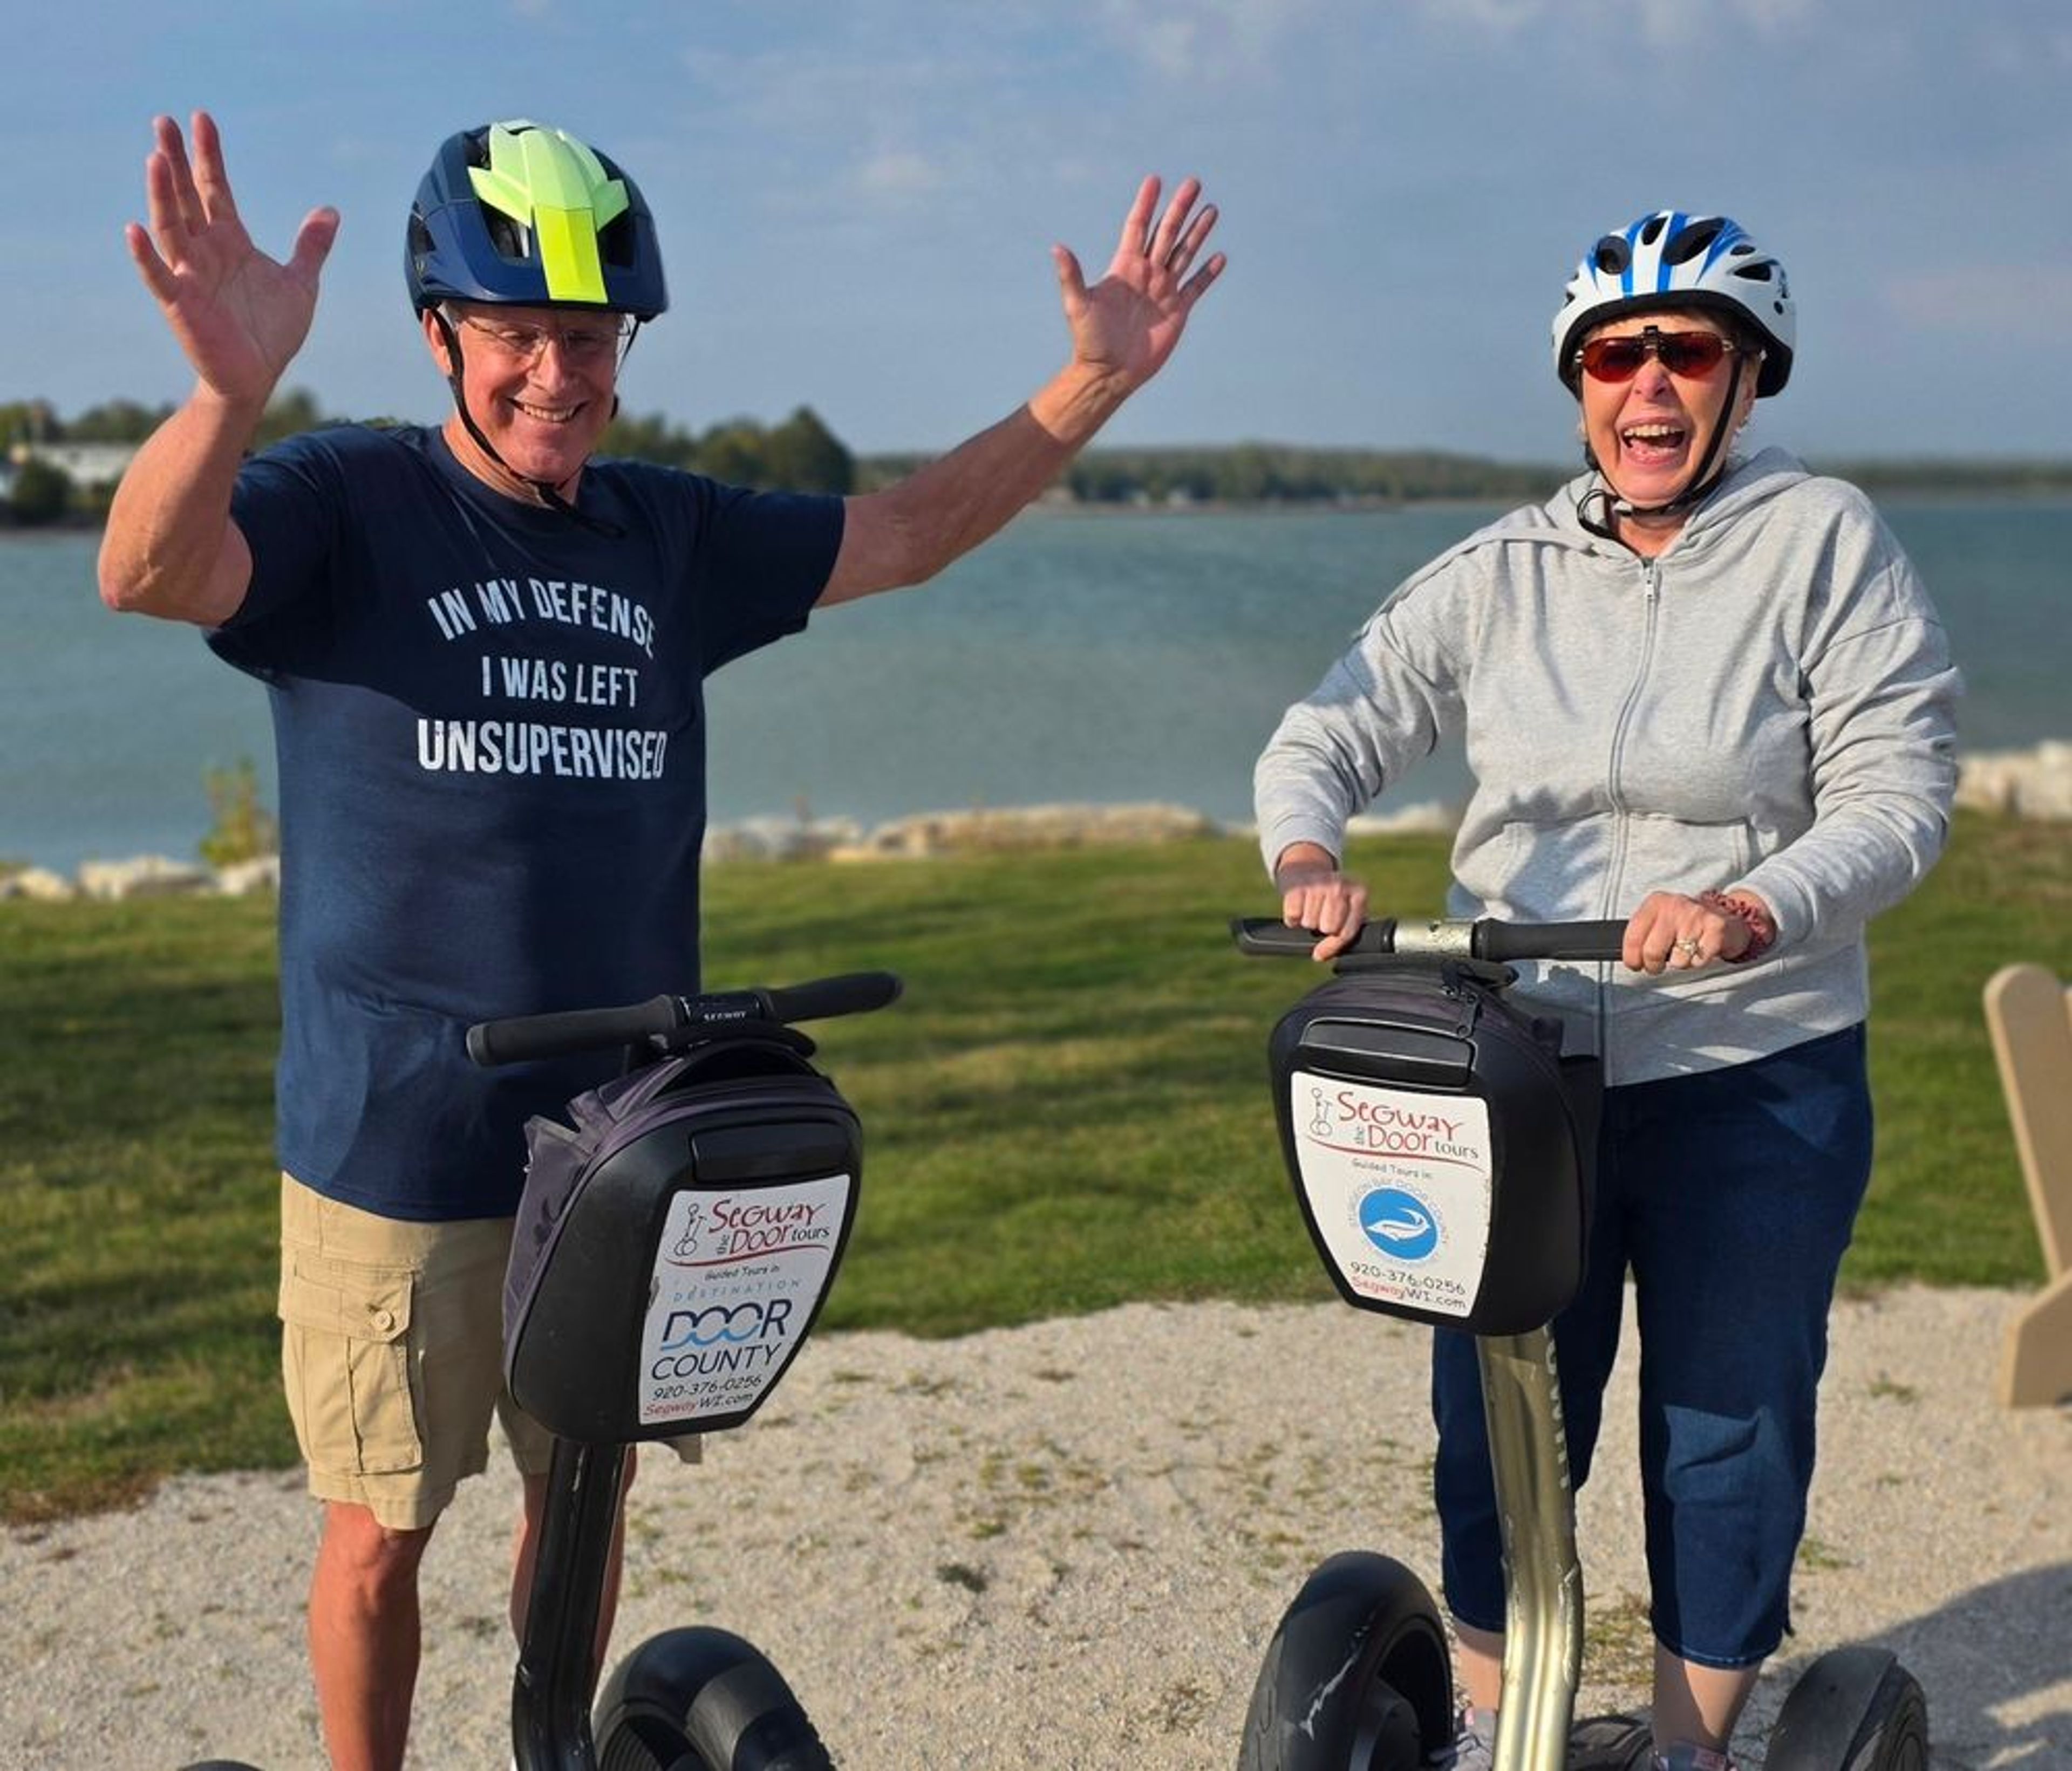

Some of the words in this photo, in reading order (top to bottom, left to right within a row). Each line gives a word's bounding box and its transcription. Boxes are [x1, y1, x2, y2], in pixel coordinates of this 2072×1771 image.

[428, 588, 477, 640] IN
[475, 578, 526, 624] MY
[528, 577, 656, 659] DEFENSE
[482, 656, 490, 696] I
[501, 657, 567, 702] WAS
[575, 663, 639, 708] LEFT
[417, 718, 668, 781] UNSUPERVISED
[1368, 1124, 1433, 1151] Door
[1434, 1140, 1479, 1159] tours
[729, 1224, 793, 1254] Door
[792, 1226, 830, 1242] tours
[1350, 1261, 1466, 1295] 920-376-0256
[660, 1298, 793, 1350] DOOR
[651, 1342, 782, 1380] COUNTY
[652, 1374, 762, 1401] 920-376-0256
